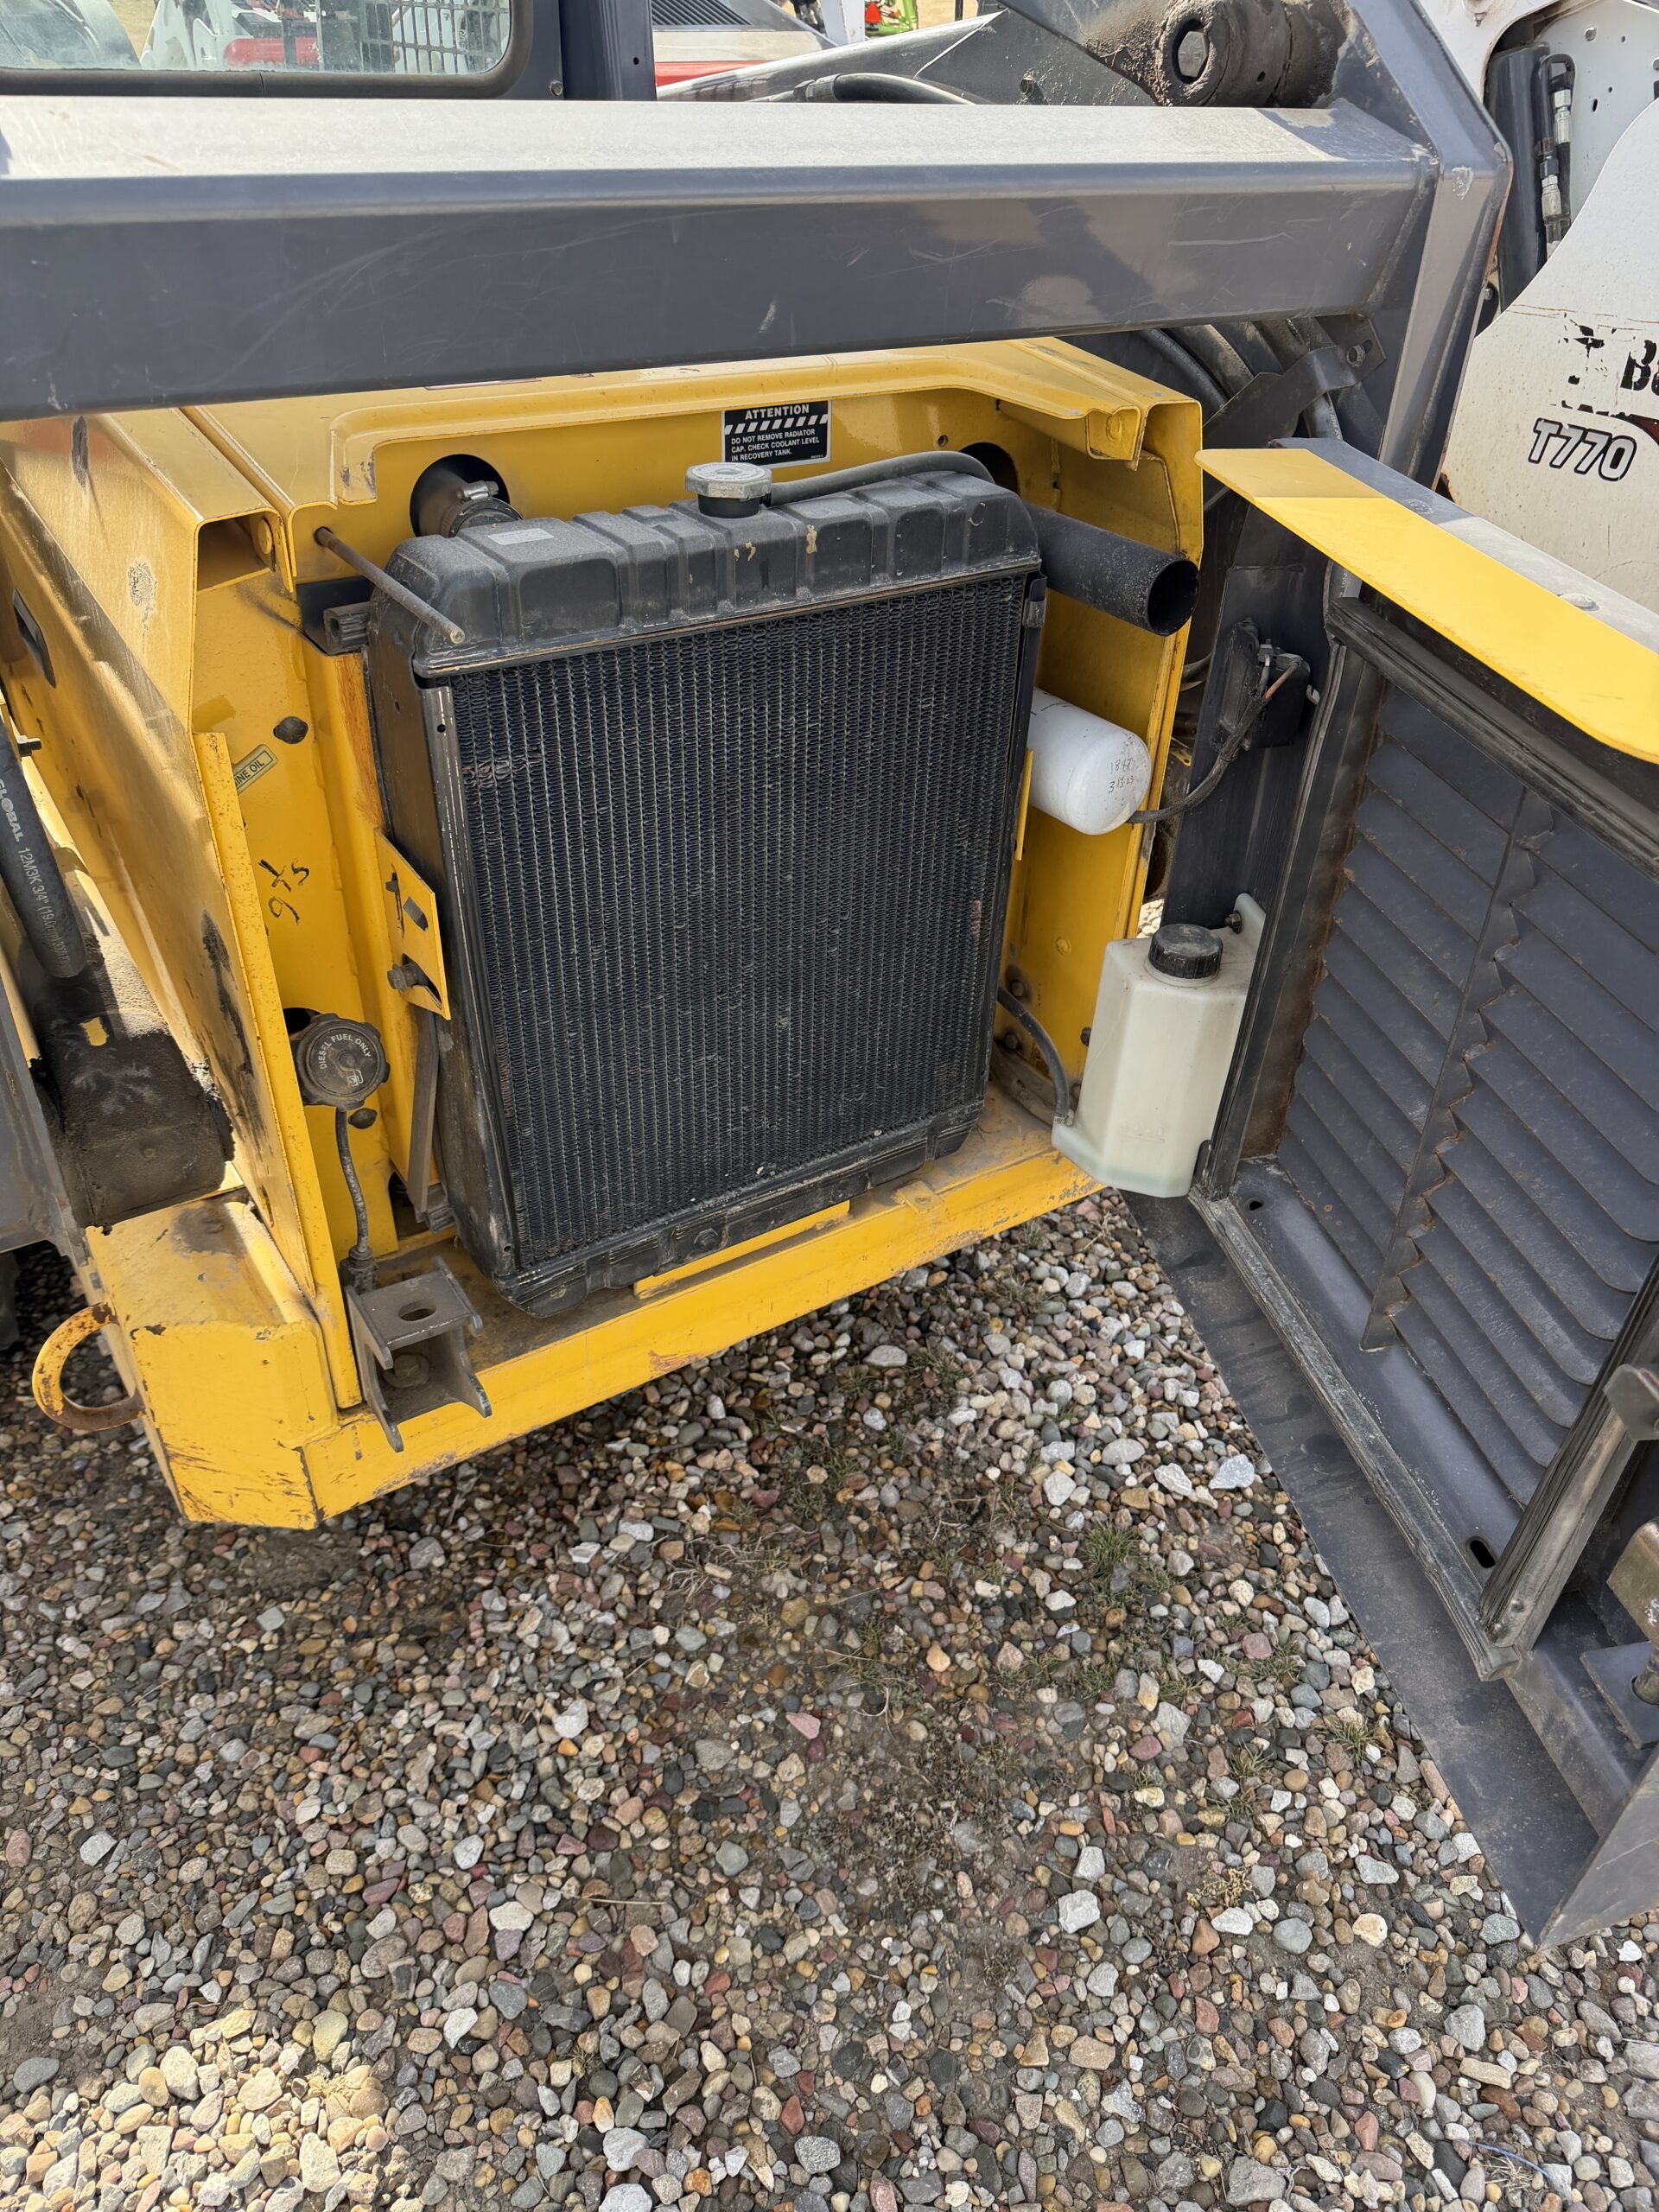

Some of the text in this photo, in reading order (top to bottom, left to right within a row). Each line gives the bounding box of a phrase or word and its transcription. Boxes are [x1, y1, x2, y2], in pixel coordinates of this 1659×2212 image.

[745, 404, 810, 420] ATTENTION
[757, 433, 783, 442] REMOVE
[785, 429, 816, 438] RADIATOR
[731, 436, 820, 454] CAP. CHECK COOLANT LEVEL
[1528, 417, 1637, 481] T770
[740, 450, 773, 461] RECOVERY
[774, 448, 792, 457] TANK.
[249, 760, 265, 772] OIL
[18, 848, 41, 885] 12M3K
[318, 1033, 372, 1070] DIESEL FUEL ONLY
